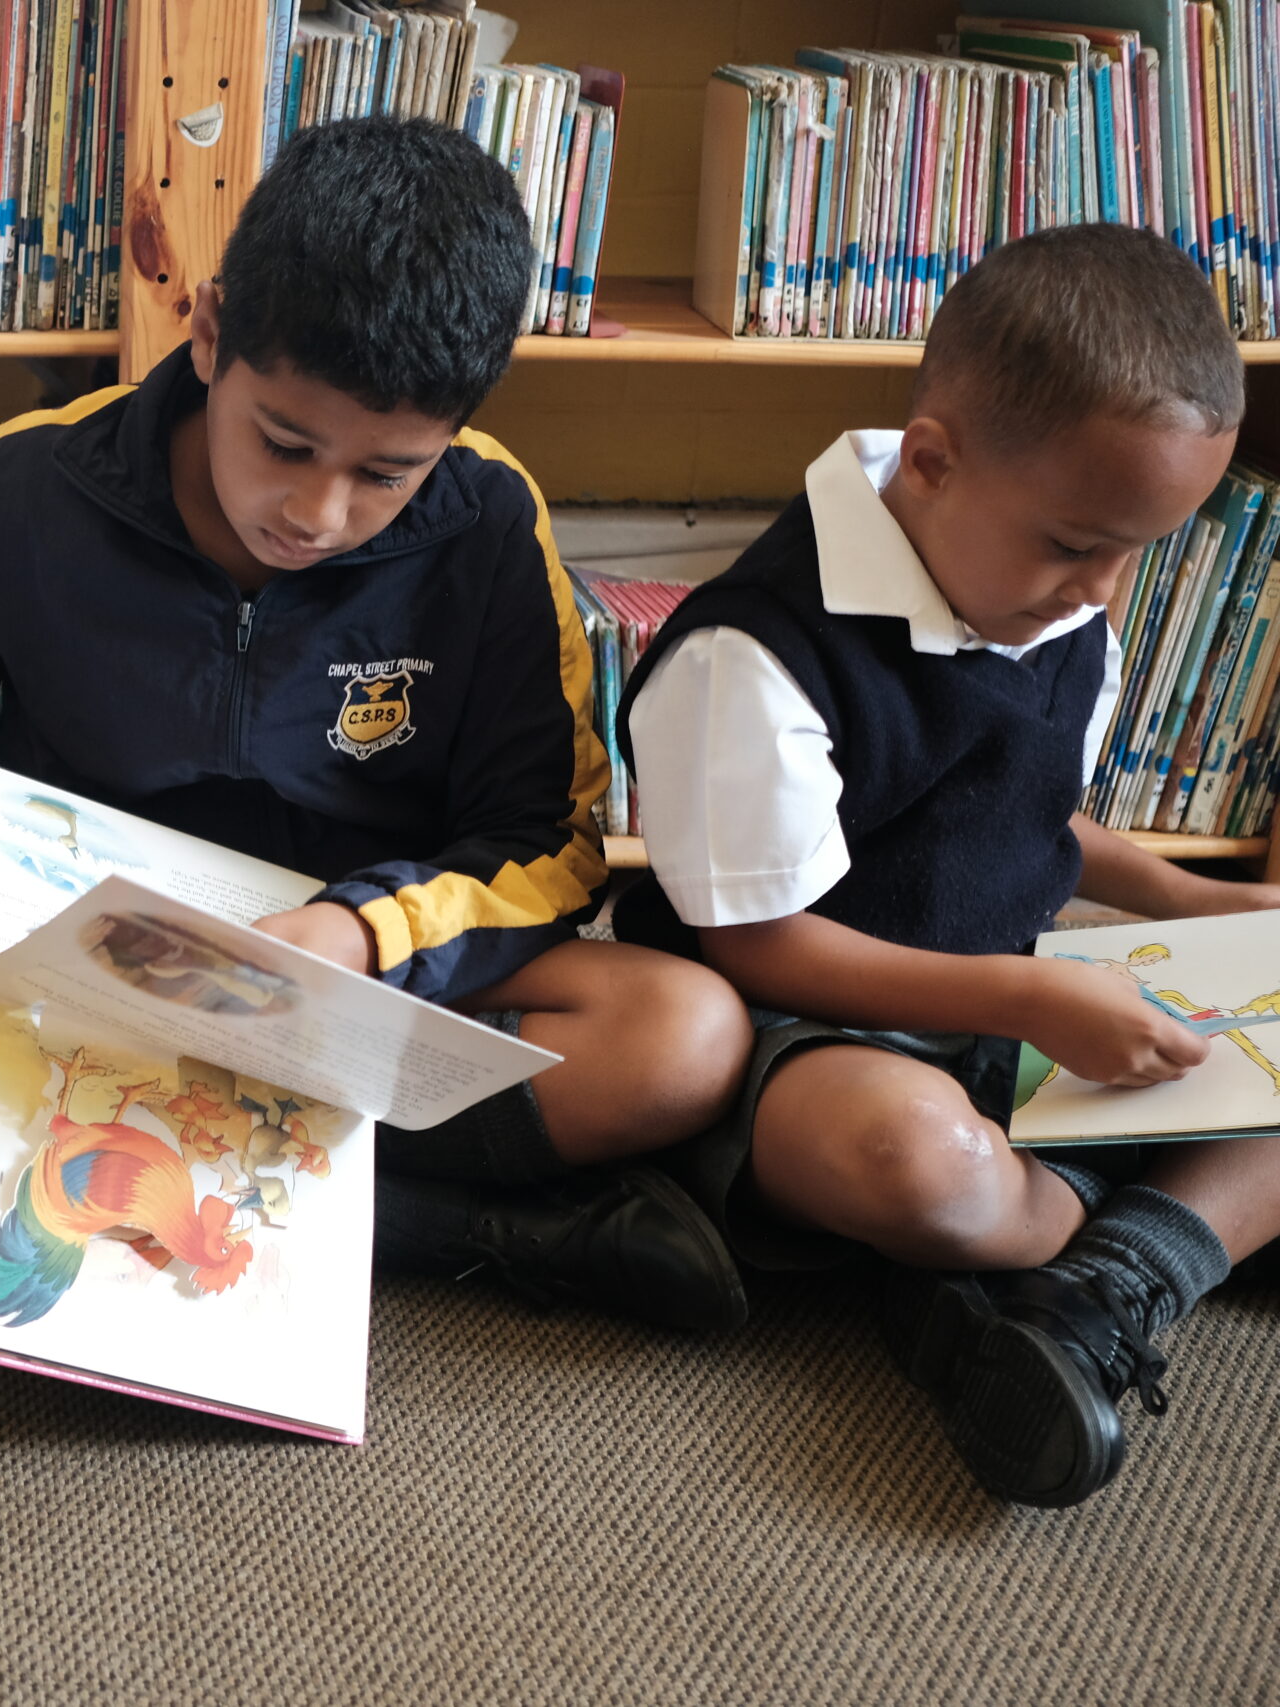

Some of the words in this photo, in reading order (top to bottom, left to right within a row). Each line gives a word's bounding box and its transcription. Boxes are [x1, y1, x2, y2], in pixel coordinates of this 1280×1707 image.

[276, 15, 288, 57] ONCE
[271, 66, 284, 108] UPON
[268, 115, 279, 126] A
[116, 139, 124, 168] BINK
[599, 146, 609, 163] The
[1104, 137, 1112, 172] WEATHER
[596, 166, 608, 189] Little
[1106, 174, 1114, 207] MACHINE
[113, 181, 123, 220] GOLLIE
[587, 192, 602, 230] Mermaid
[328, 663, 363, 677] CHAPEL
[366, 660, 396, 675] STREET
[398, 658, 434, 675] PRIMARY
